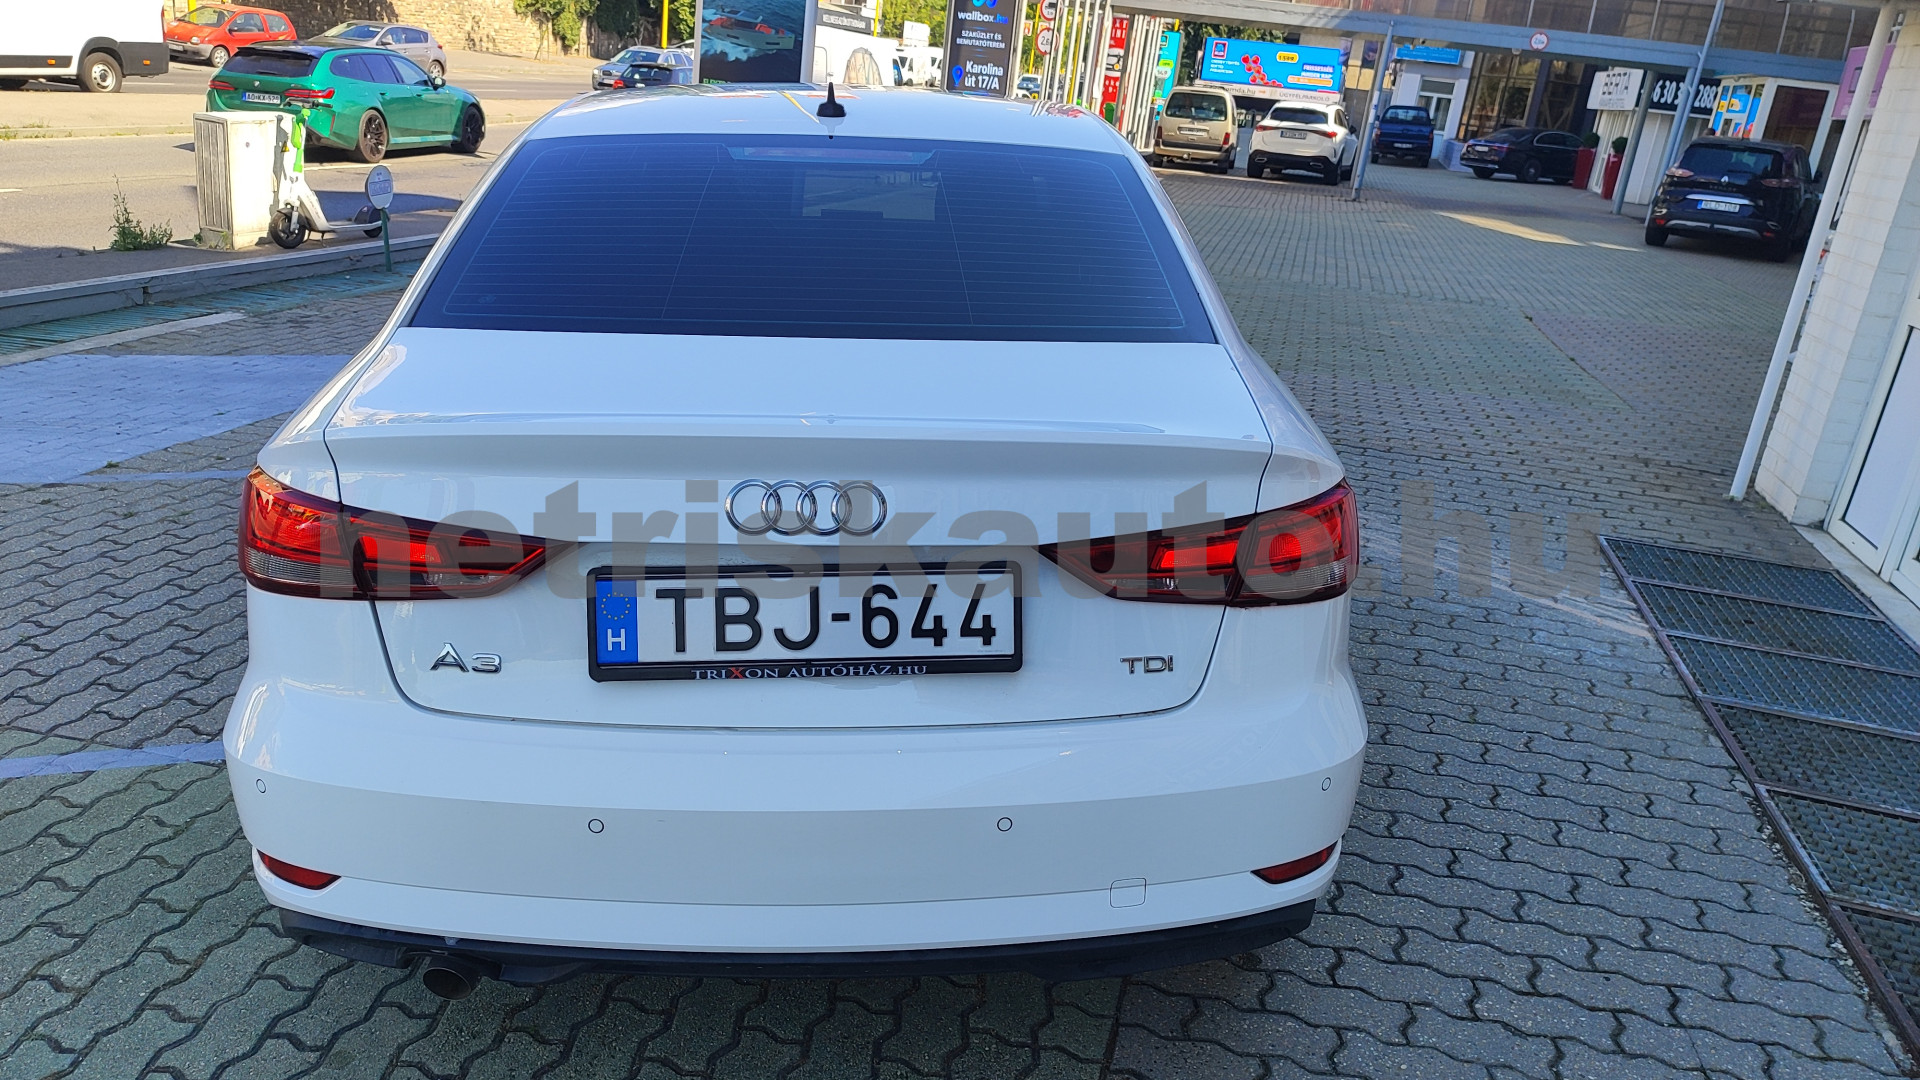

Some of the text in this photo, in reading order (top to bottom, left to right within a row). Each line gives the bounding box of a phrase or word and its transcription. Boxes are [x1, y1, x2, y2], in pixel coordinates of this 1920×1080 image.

[957, 11, 1008, 25] wallbox.hu
[956, 38, 1006, 49] BEMUTATÓTEREM
[961, 30, 1002, 41] SZAKÜZLET ÉS
[965, 60, 1004, 77] Karolina
[964, 74, 1000, 90] út 17/A
[606, 583, 997, 653] H TBJ-644
[428, 641, 503, 674] A3
[1120, 654, 1174, 675] TDI
[690, 663, 928, 681] TRIXON AUTÓHÁZ.HU
